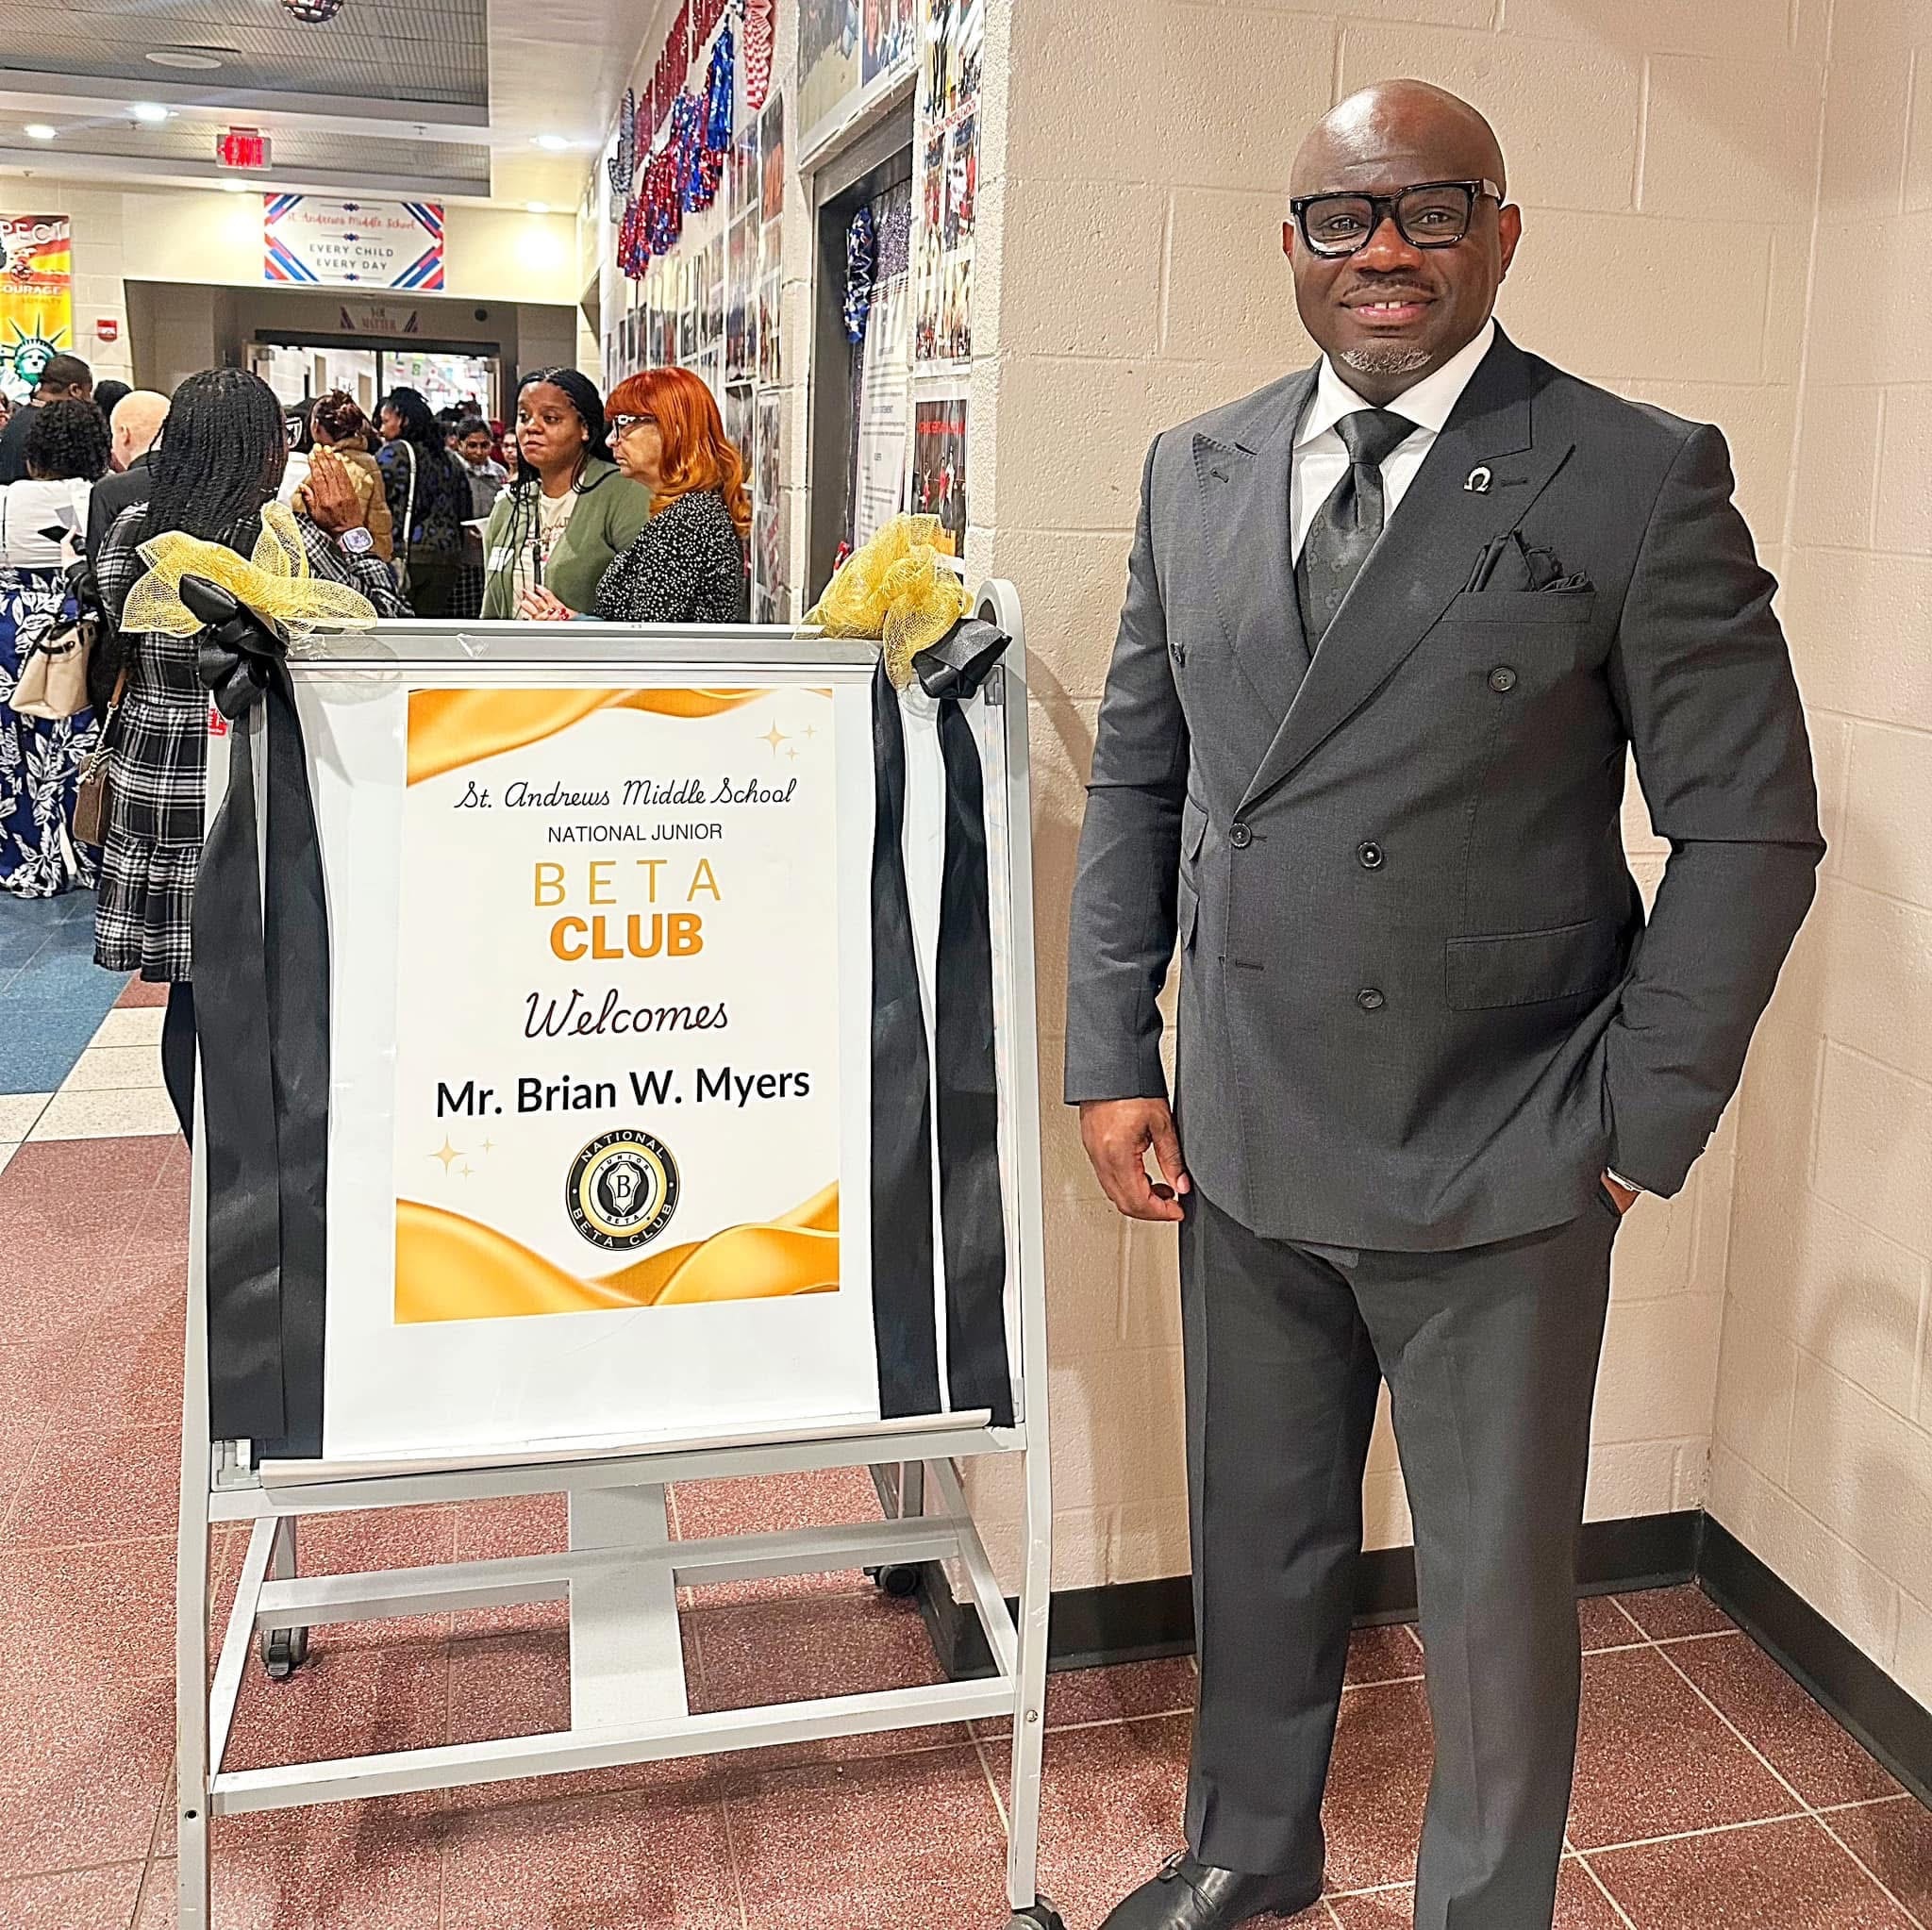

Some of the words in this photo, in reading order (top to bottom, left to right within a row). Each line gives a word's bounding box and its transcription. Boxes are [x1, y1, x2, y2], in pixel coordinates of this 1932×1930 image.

[348, 215, 382, 228] Middle
[386, 217, 416, 230] School
[309, 243, 350, 255] EVERY
[355, 246, 394, 258] CHILD
[316, 258, 356, 269] EVERY
[362, 260, 388, 271] DAY
[453, 780, 493, 809] St.
[505, 780, 611, 808] Andrews
[622, 778, 708, 806] Middle
[709, 776, 798, 805] School
[547, 825, 647, 844] NATIONAL
[651, 823, 724, 841] JUNIOR
[534, 857, 722, 907] BETA
[550, 913, 704, 961] CLUB
[525, 988, 728, 1039] Welcomes
[437, 1080, 503, 1118] Mr.
[517, 1074, 617, 1113] Brian
[629, 1070, 682, 1106] W.
[695, 1066, 810, 1108] Myers
[581, 1131, 665, 1163] NATIONAL
[599, 1155, 650, 1171] JUNIOR
[616, 1175, 631, 1198] B
[573, 1208, 614, 1247] BETA
[629, 1204, 672, 1245] CLUB
[606, 1214, 640, 1224] BETA
